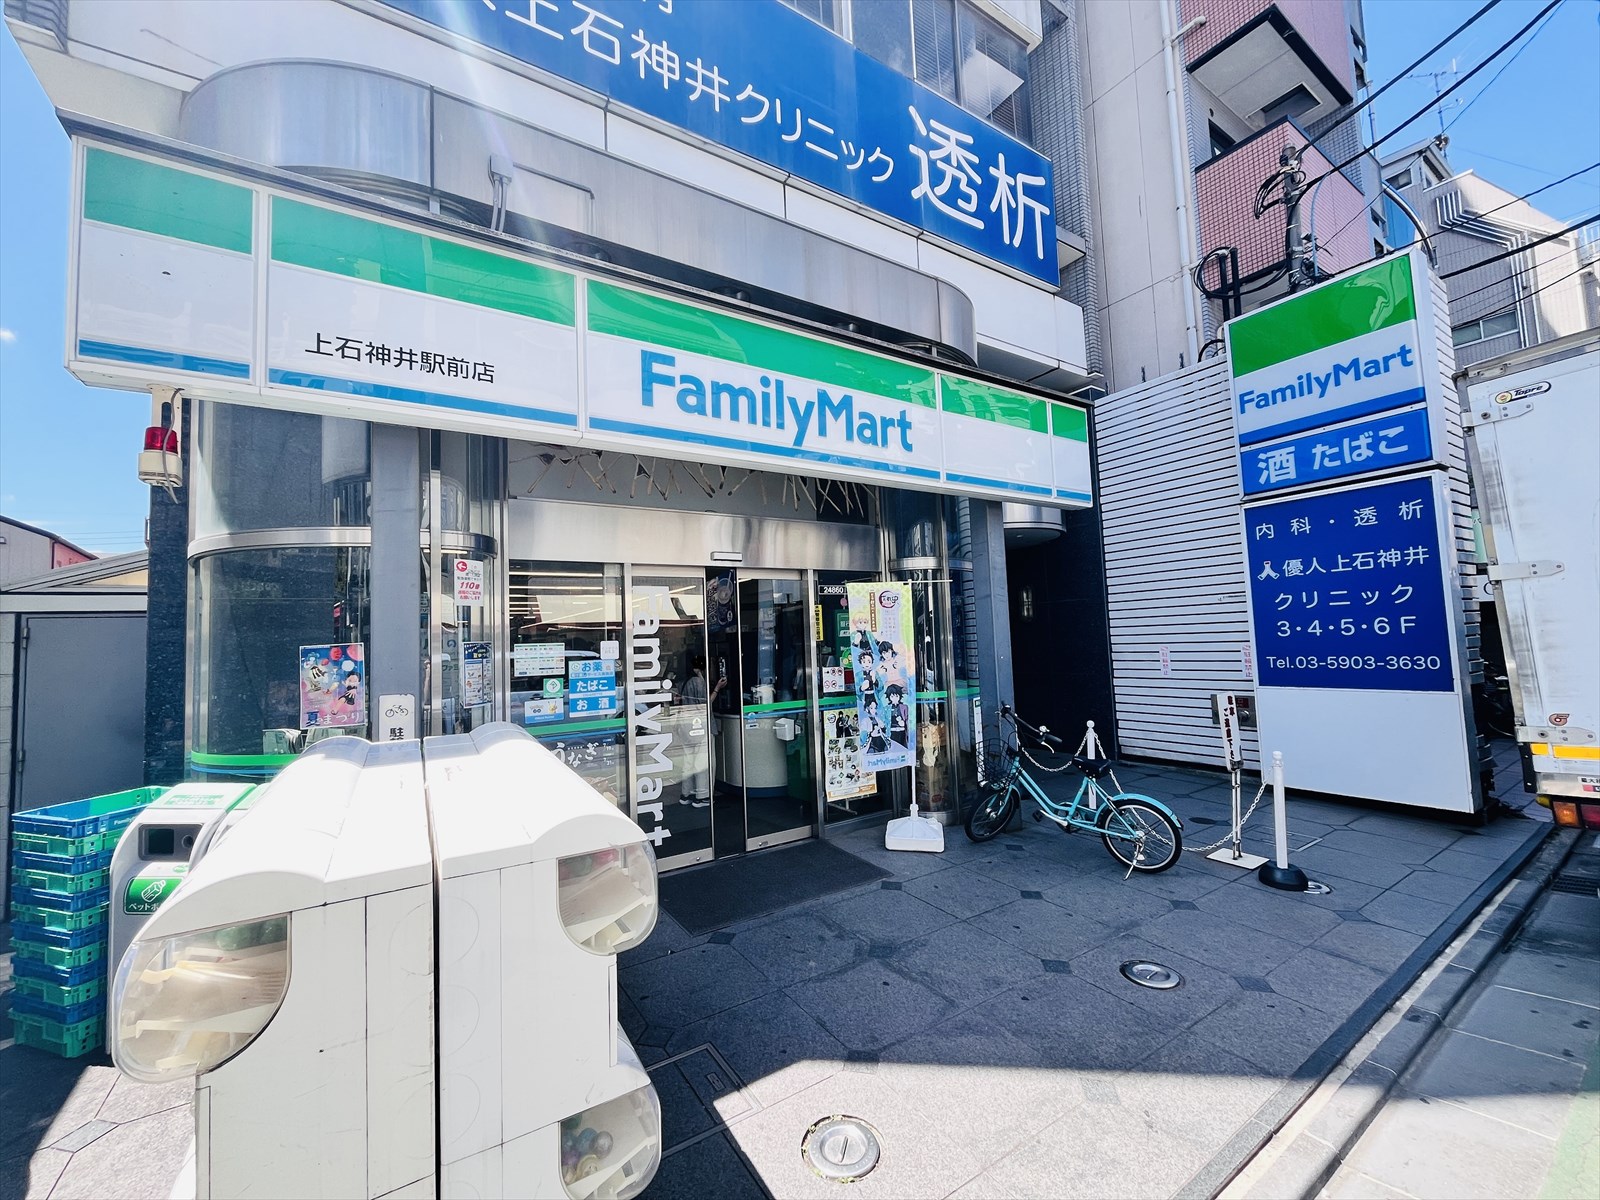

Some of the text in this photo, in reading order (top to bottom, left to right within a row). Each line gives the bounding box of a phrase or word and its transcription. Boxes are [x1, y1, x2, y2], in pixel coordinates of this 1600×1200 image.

[482, 0, 895, 182] 上石神井クリニック
[908, 106, 1051, 260] 透析
[304, 332, 496, 384] 上石神井駅前店
[1238, 343, 1414, 415] FamilyMart
[640, 349, 913, 452] FamilyMart
[1514, 385, 1543, 396] Topre
[1257, 425, 1409, 485] 酒 たばこ
[1282, 545, 1430, 577] 優人上石神井
[1274, 584, 1414, 612] クリニック
[576, 680, 609, 692] たばこ
[582, 661, 602, 671] お薬
[1266, 655, 1441, 671] Tel.03-5903-3630
[632, 585, 673, 847] FamilyMart
